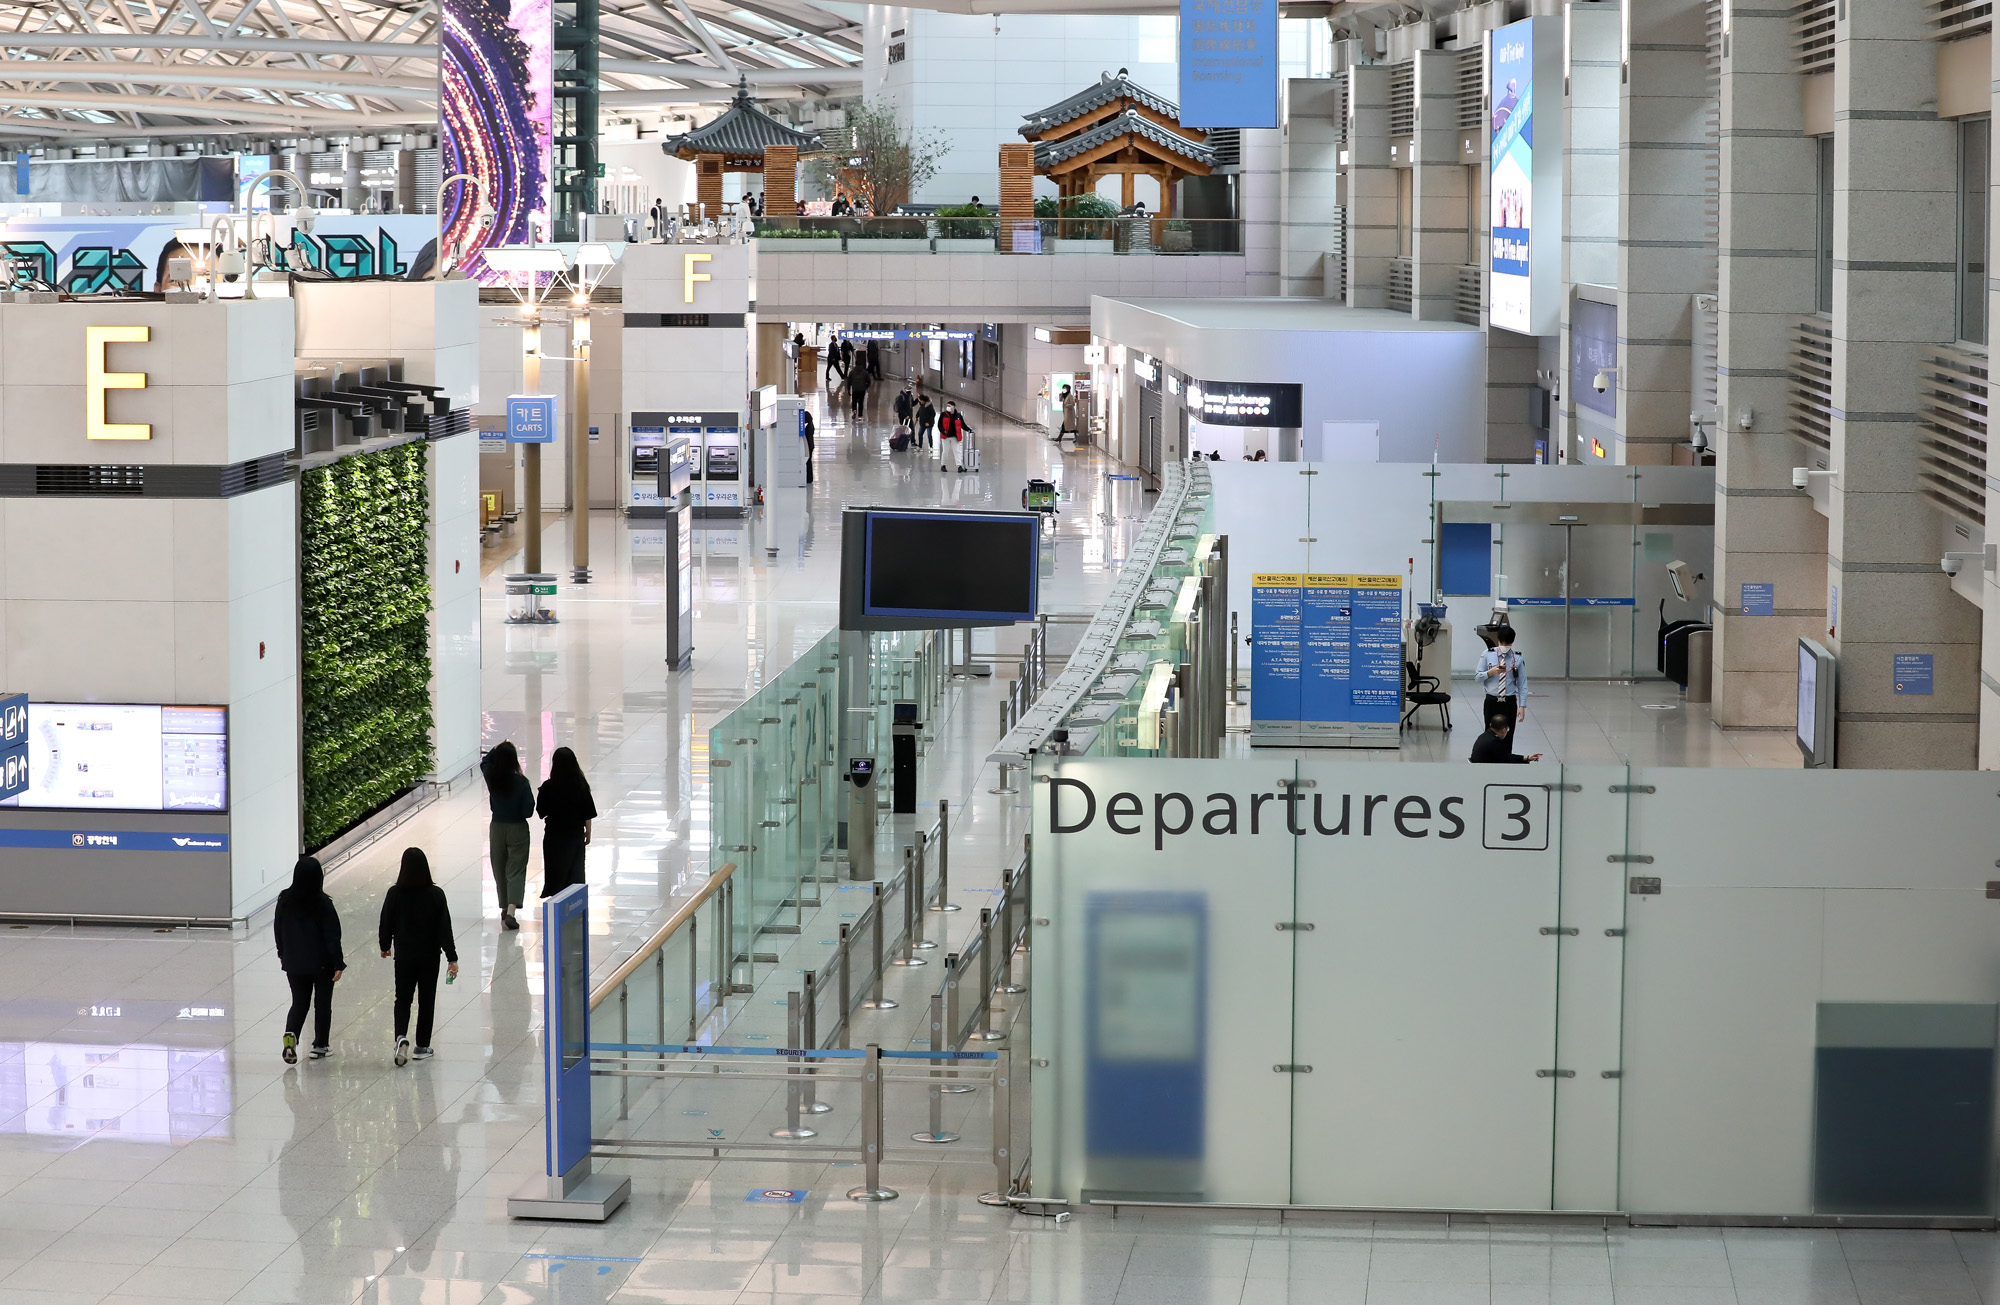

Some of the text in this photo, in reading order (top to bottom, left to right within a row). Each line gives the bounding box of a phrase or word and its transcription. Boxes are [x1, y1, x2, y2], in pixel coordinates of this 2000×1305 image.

[1192, 56, 1263, 67] International
[1192, 70, 1243, 84] Boarding
[684, 253, 712, 302] F
[86, 326, 152, 440] E
[517, 408, 542, 422] 카트
[1049, 776, 1532, 850] Departures 3
[87, 835, 118, 845] 공항안내
